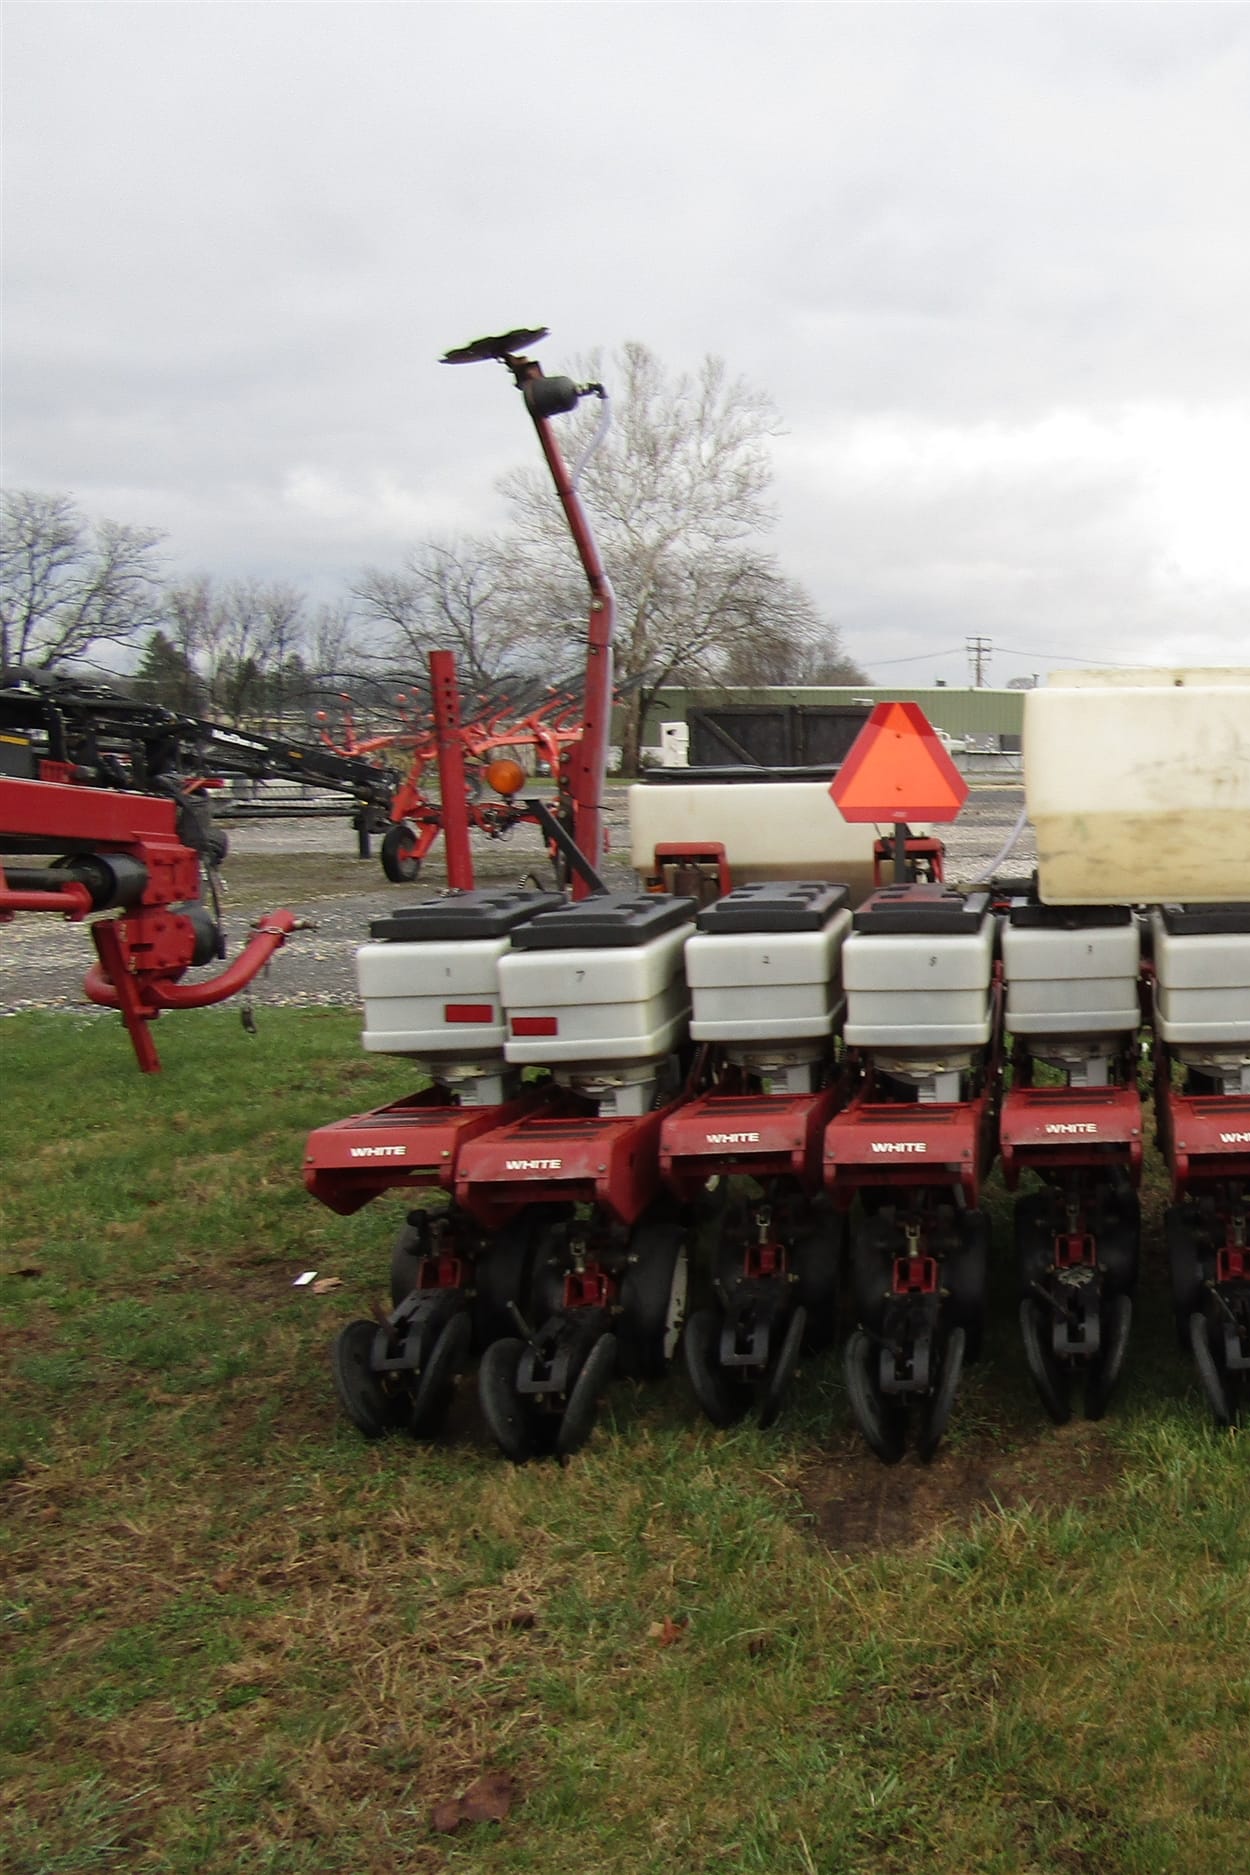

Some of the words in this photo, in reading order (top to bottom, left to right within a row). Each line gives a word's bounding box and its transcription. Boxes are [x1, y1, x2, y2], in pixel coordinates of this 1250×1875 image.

[762, 955, 770, 966] 2
[575, 970, 585, 983] 7
[1043, 1123, 1098, 1135] WHITE
[705, 1132, 761, 1144] WHITE
[349, 1145, 407, 1158] WHITE
[870, 1142, 927, 1154] WHITE
[505, 1159, 562, 1171] WHITE
